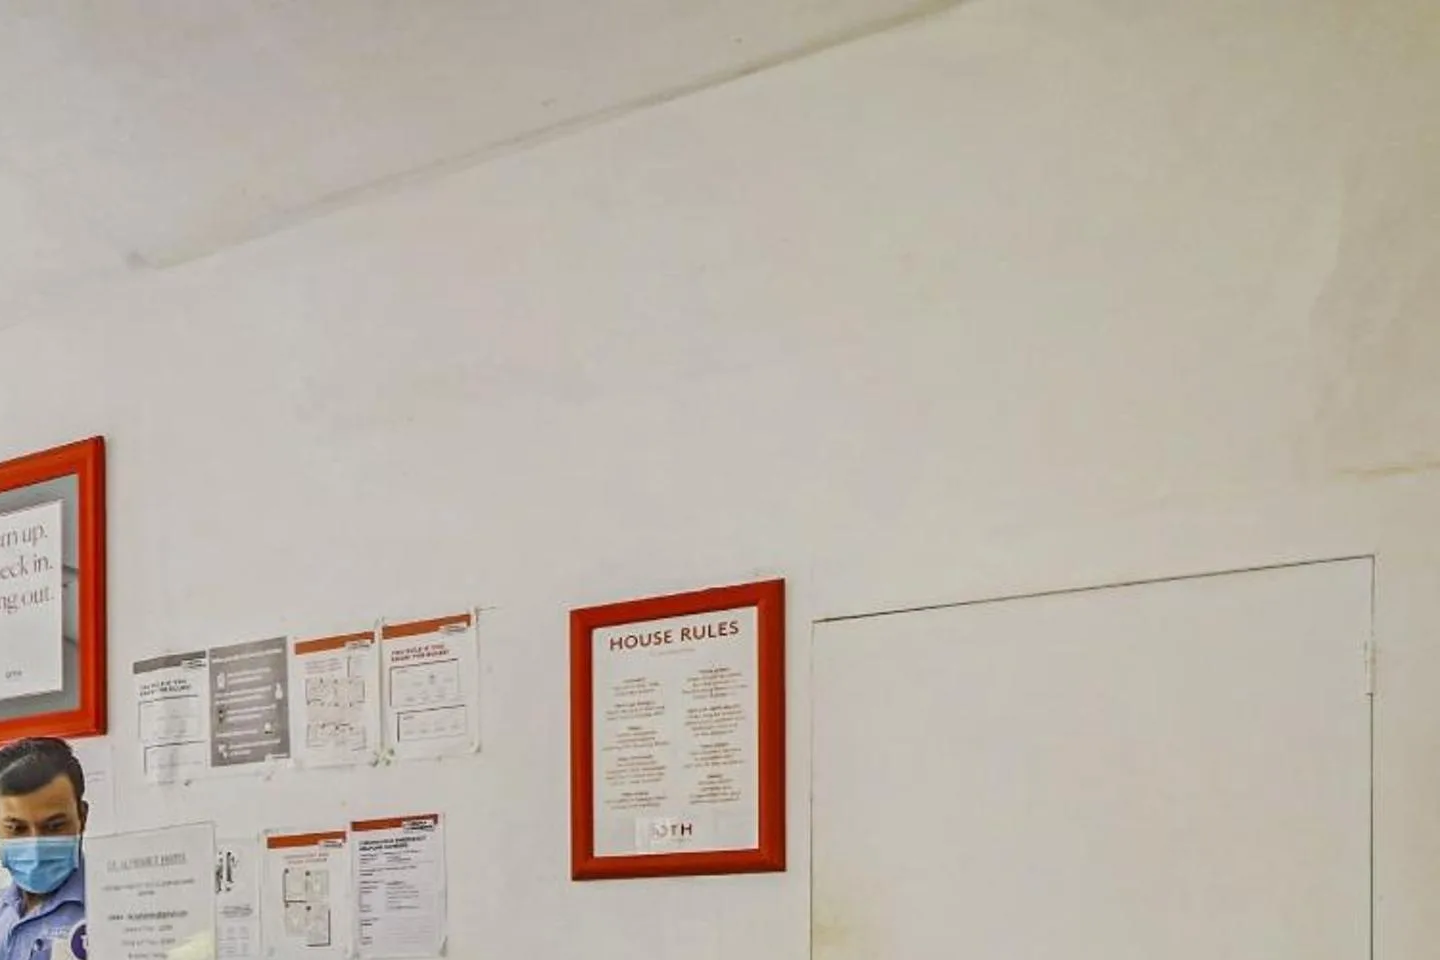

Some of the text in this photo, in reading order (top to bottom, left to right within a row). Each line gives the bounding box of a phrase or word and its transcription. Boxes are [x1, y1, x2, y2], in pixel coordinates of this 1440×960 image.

[32, 554, 54, 574] in.
[21, 585, 55, 605] out.
[609, 620, 740, 652] HOUSE RULES
